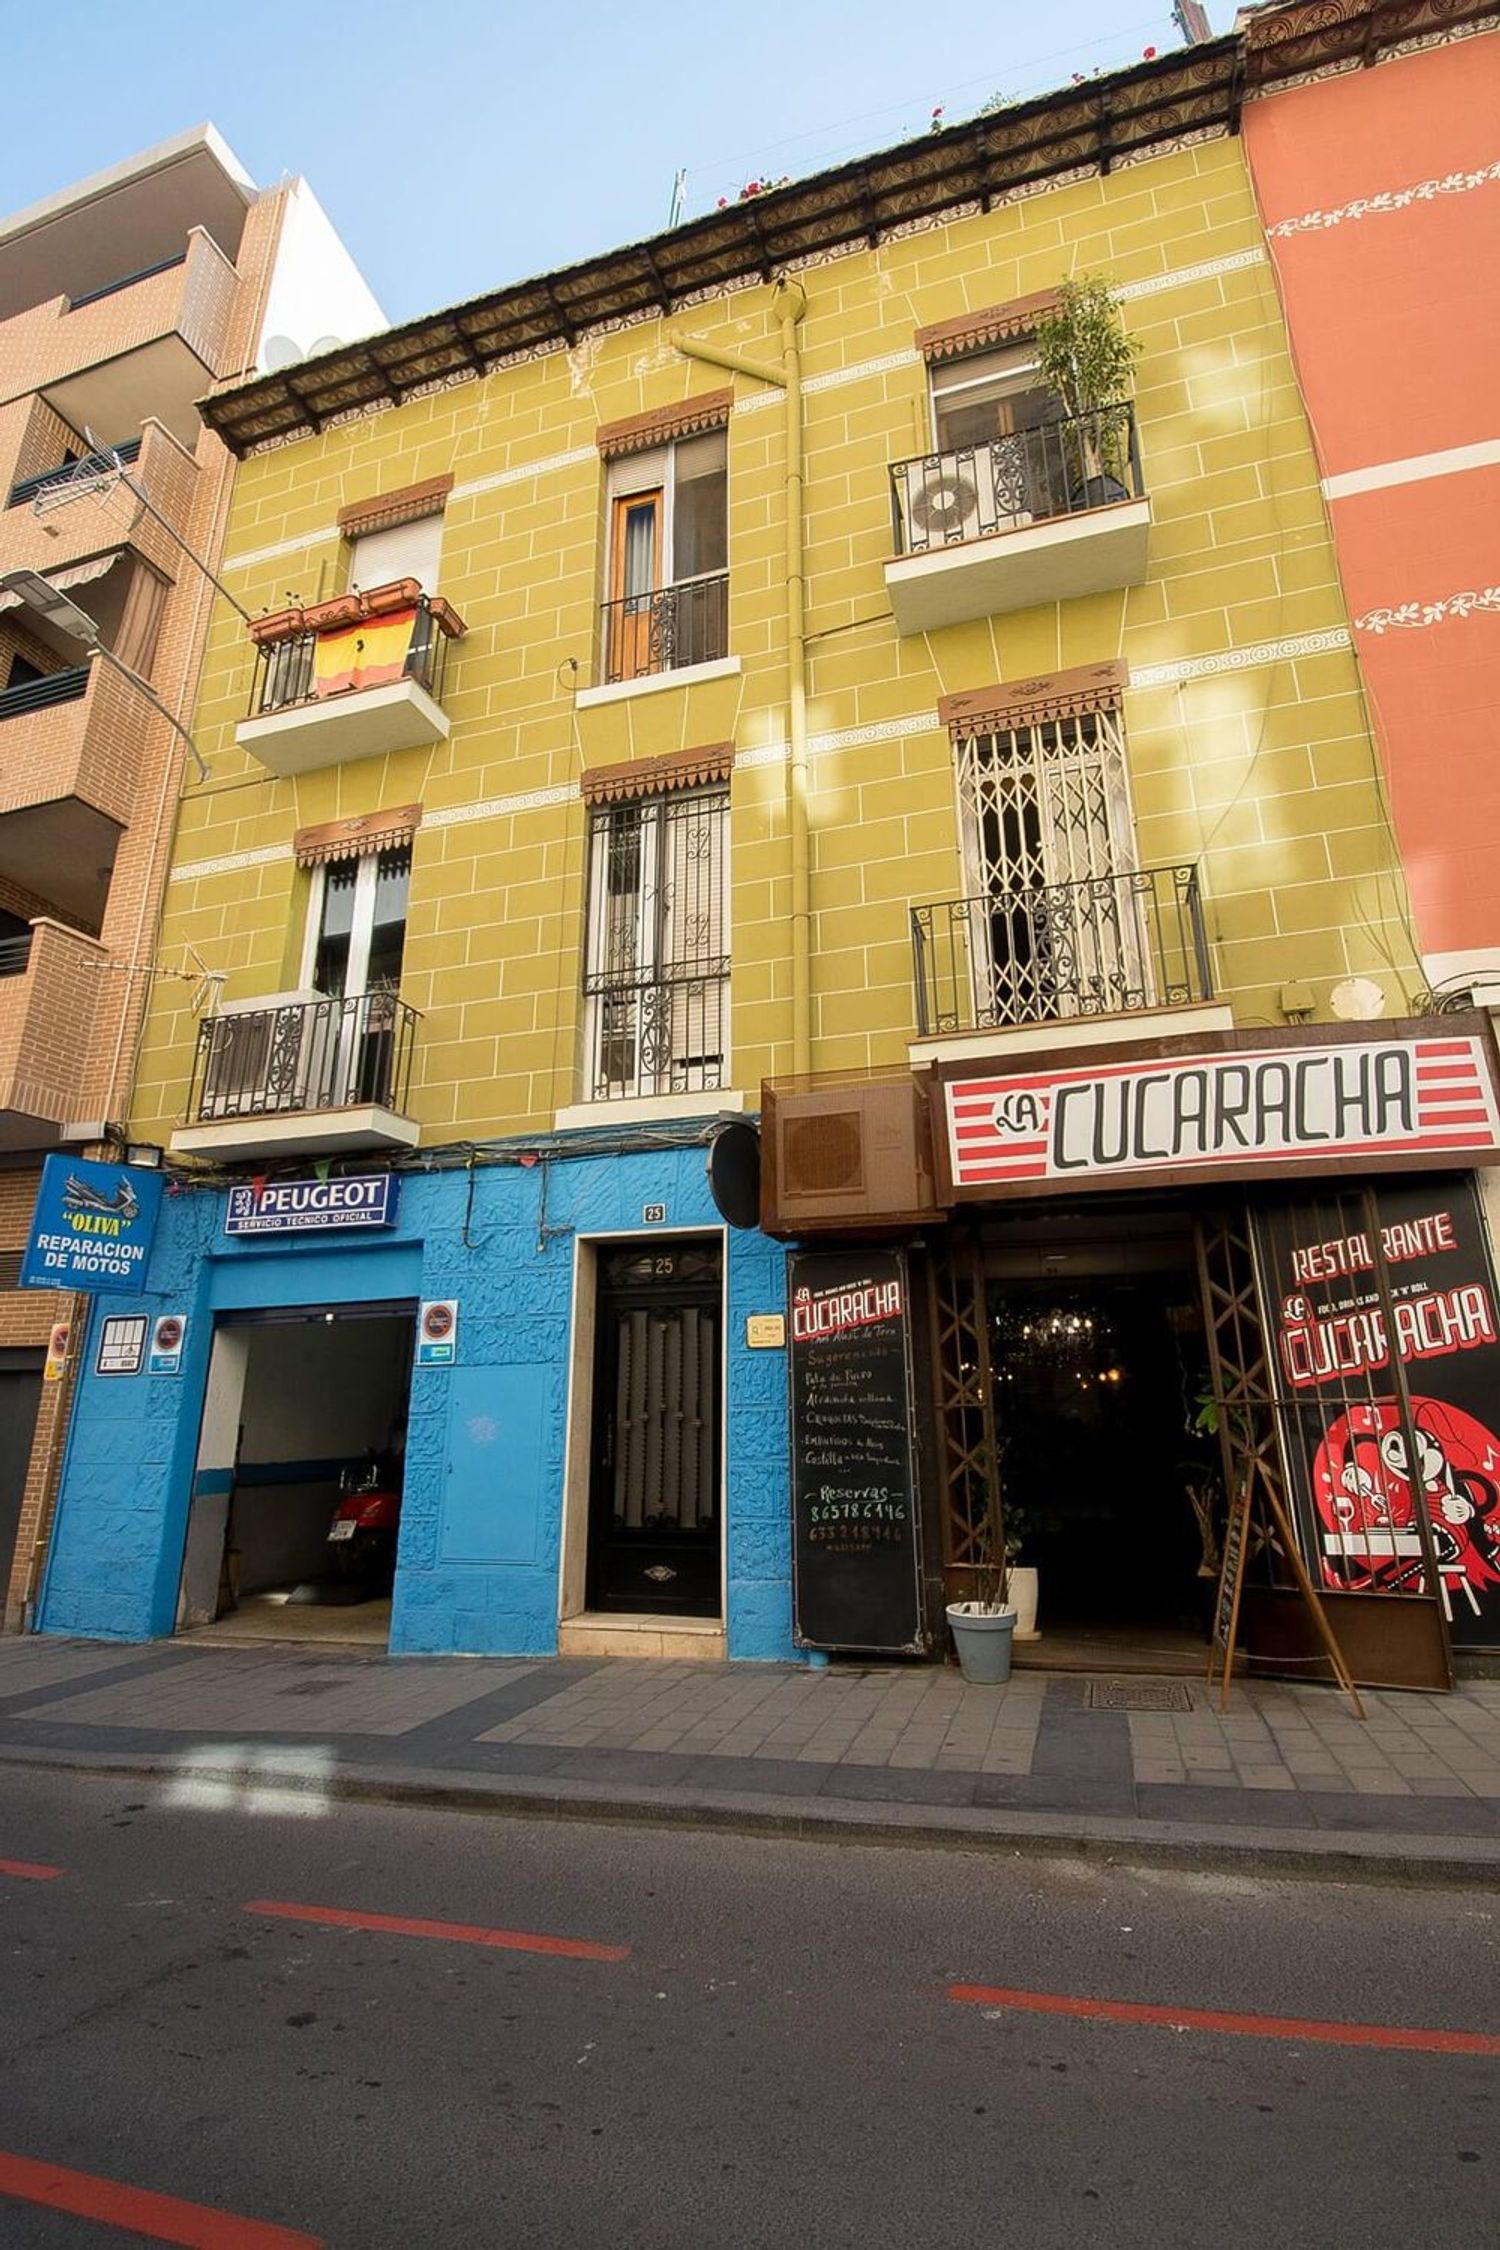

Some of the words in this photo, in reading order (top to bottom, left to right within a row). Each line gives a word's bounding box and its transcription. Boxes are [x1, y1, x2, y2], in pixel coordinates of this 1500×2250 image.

[995, 1093, 1039, 1131] LA
[1052, 1049, 1414, 1169] CUCARACHA
[260, 1182, 381, 1212] PEUGEOT
[238, 1219, 281, 1229] SERVICIO
[287, 1215, 328, 1225] TECNICO
[333, 1212, 372, 1222] OFICIAL
[647, 1207, 661, 1220] 25
[37, 1234, 144, 1260] REPARACION
[44, 1252, 69, 1268] DE
[72, 1255, 131, 1275] MOTOS
[655, 1257, 674, 1274] 25
[796, 1288, 810, 1302] LA
[794, 1281, 900, 1336] CUCARACHA
[820, 1485, 888, 1503] Reservas
